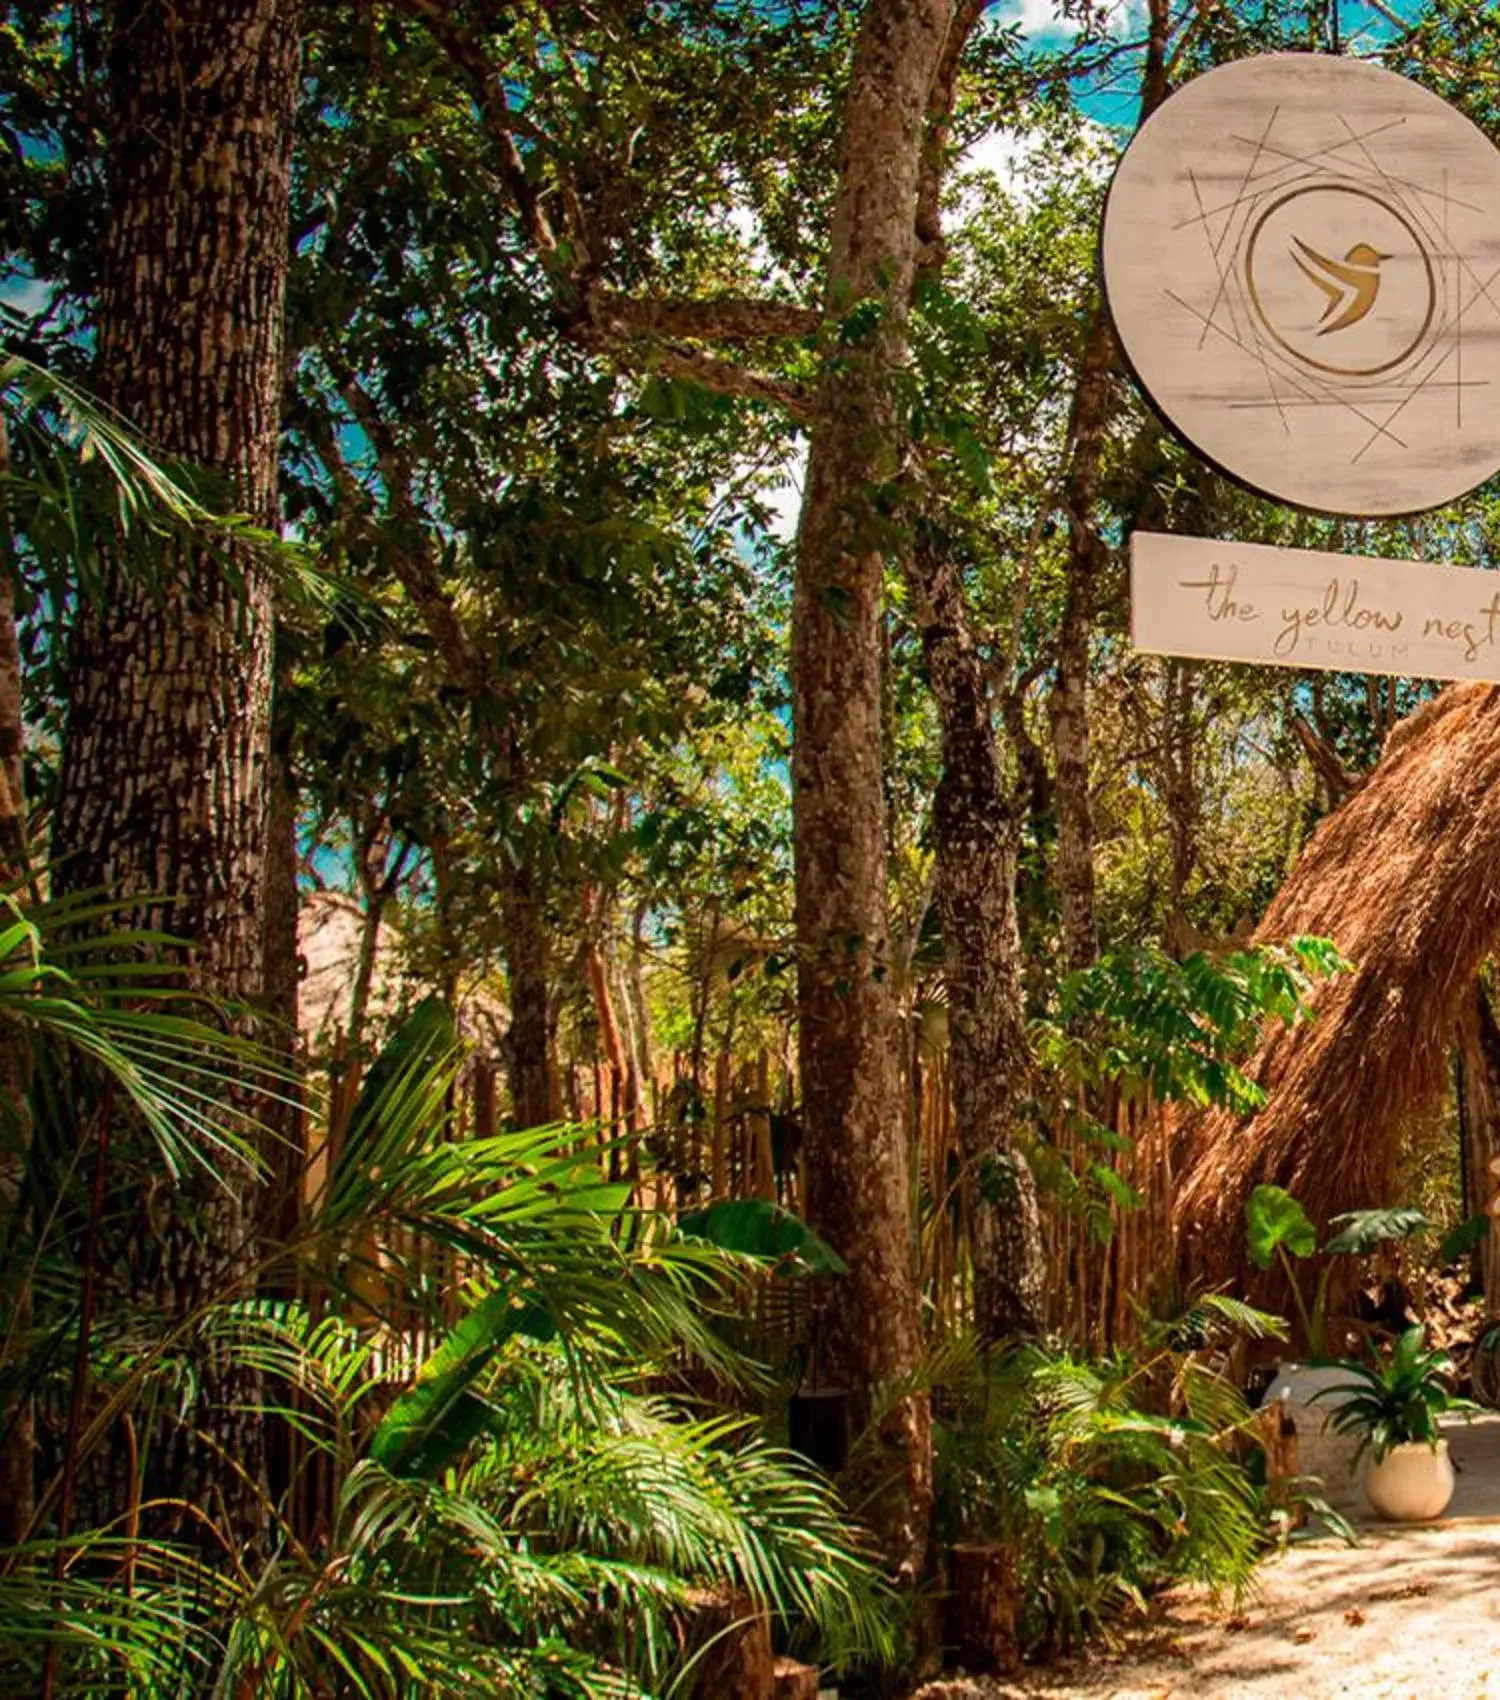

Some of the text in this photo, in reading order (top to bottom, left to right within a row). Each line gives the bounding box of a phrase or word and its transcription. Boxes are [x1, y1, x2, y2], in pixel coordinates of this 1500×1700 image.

[1179, 563, 1262, 621] the
[1273, 578, 1403, 657] yellow
[1306, 637, 1409, 659] TULUM
